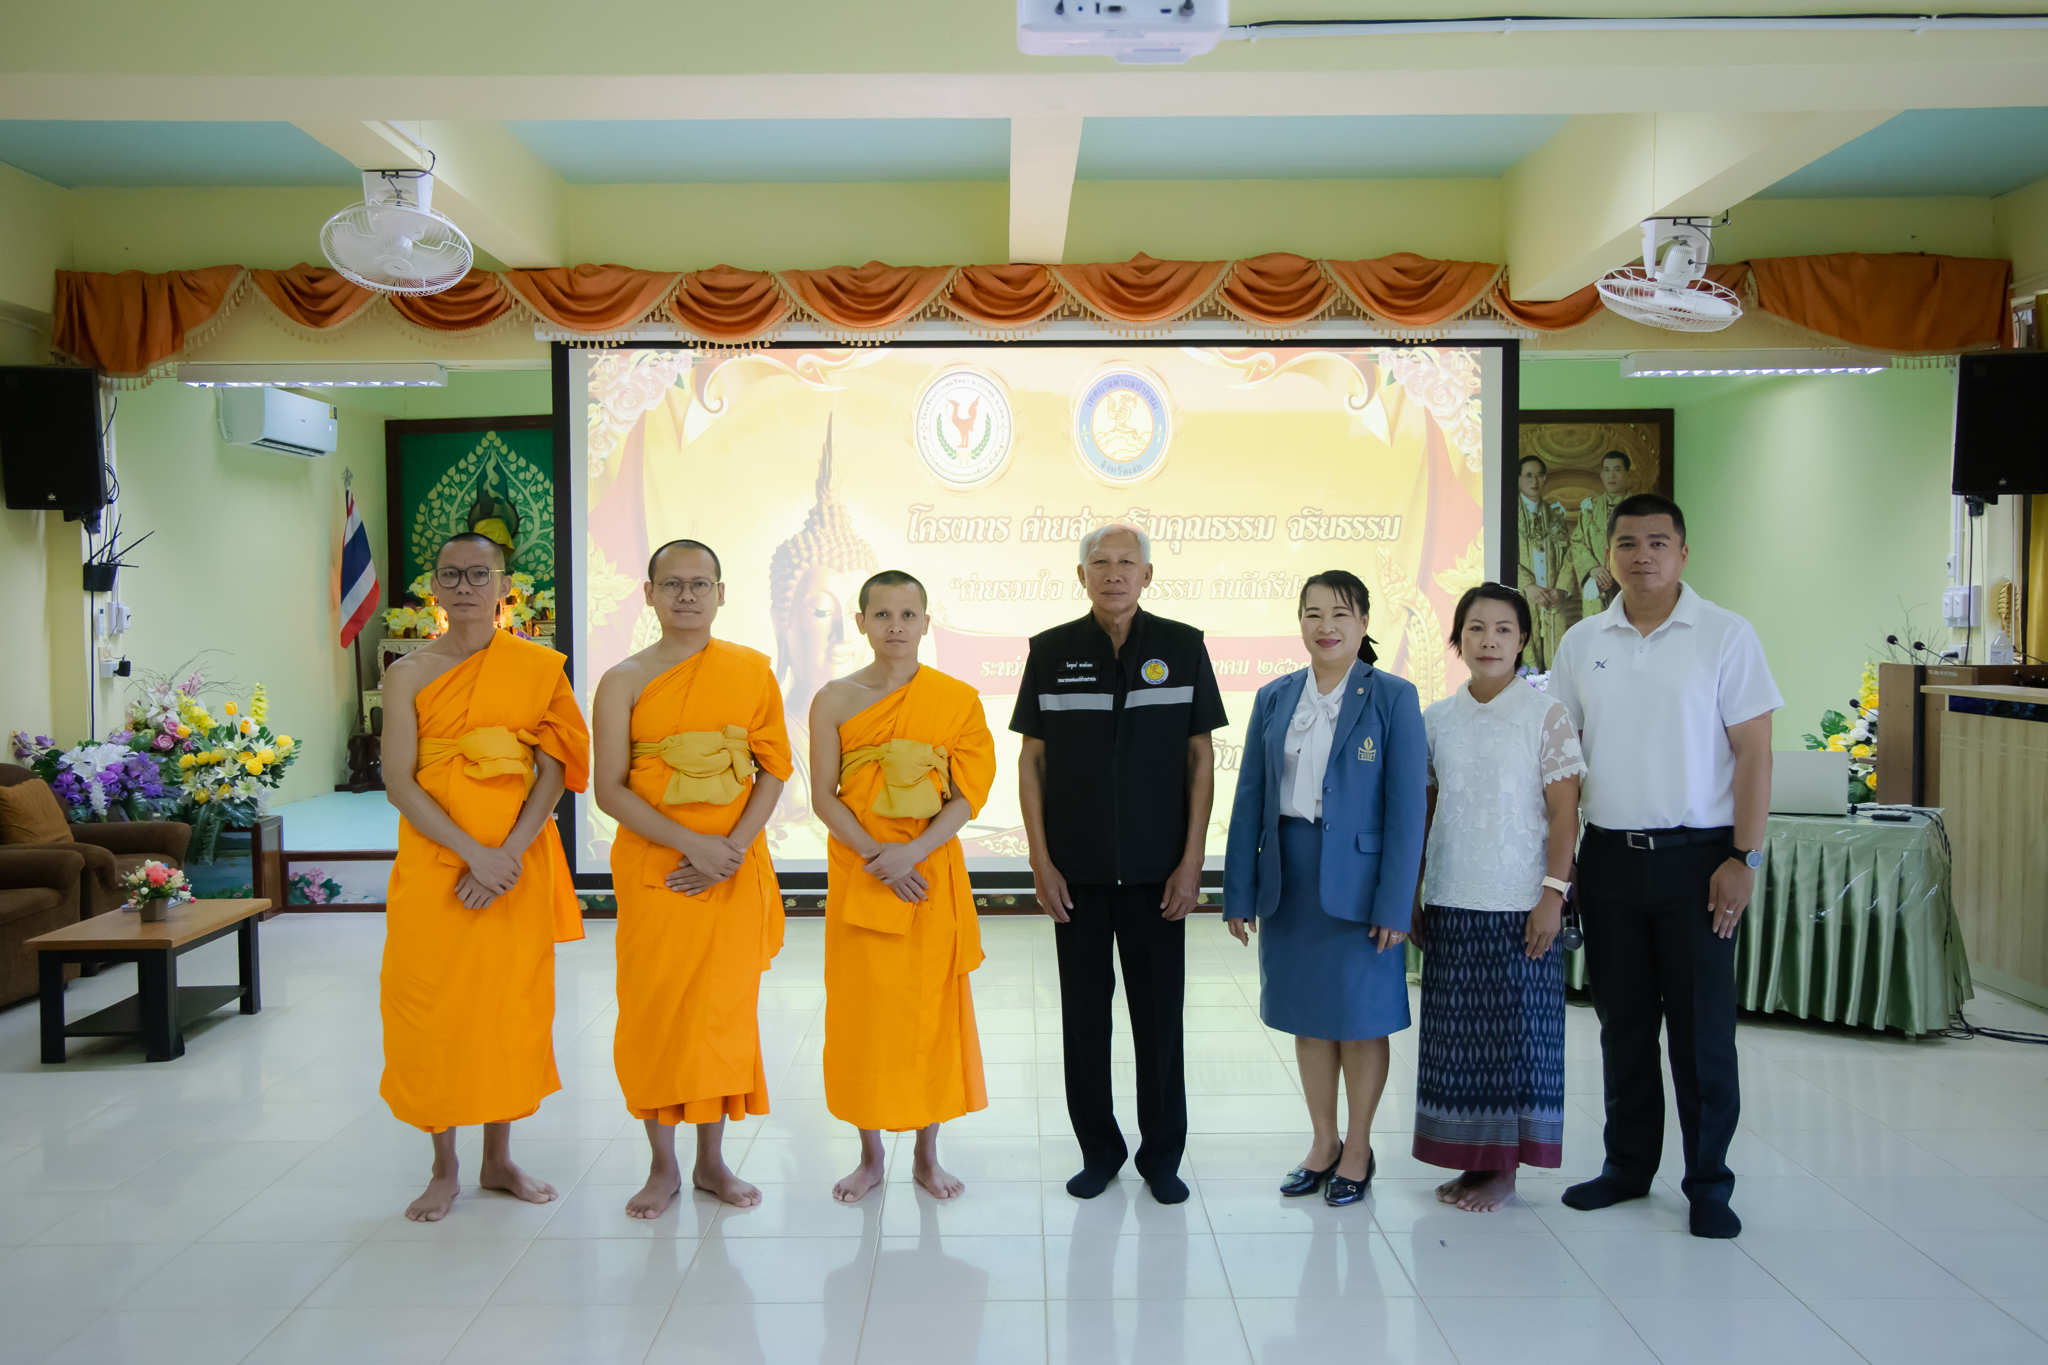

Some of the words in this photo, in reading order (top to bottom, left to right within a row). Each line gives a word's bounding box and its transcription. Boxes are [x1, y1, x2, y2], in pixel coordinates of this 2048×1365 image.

[1086, 375, 1159, 410] เทศบาลตำบลปากชม
[1100, 460, 1143, 476] จังหวัดเลย
[908, 503, 1011, 543] โครงการ
[1286, 506, 1401, 542] จริยธรรม
[1257, 658, 1309, 675] ๒๕๖
